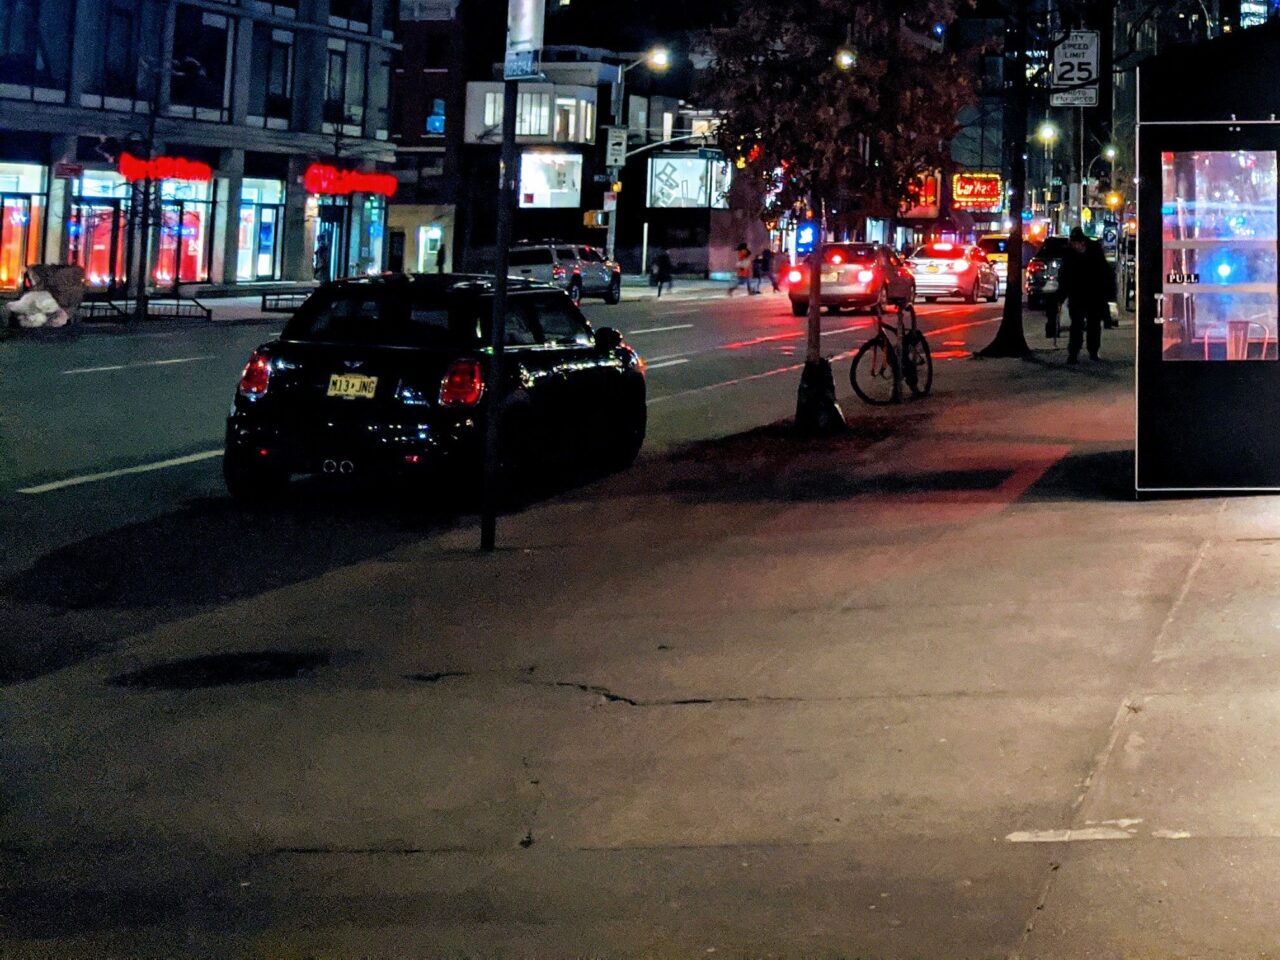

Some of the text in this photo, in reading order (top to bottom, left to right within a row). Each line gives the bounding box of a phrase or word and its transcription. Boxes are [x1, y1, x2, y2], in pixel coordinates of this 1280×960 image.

[1064, 51, 1086, 59] LIMIT
[1057, 61, 1093, 82] 25
[1169, 273, 1198, 283] PULL
